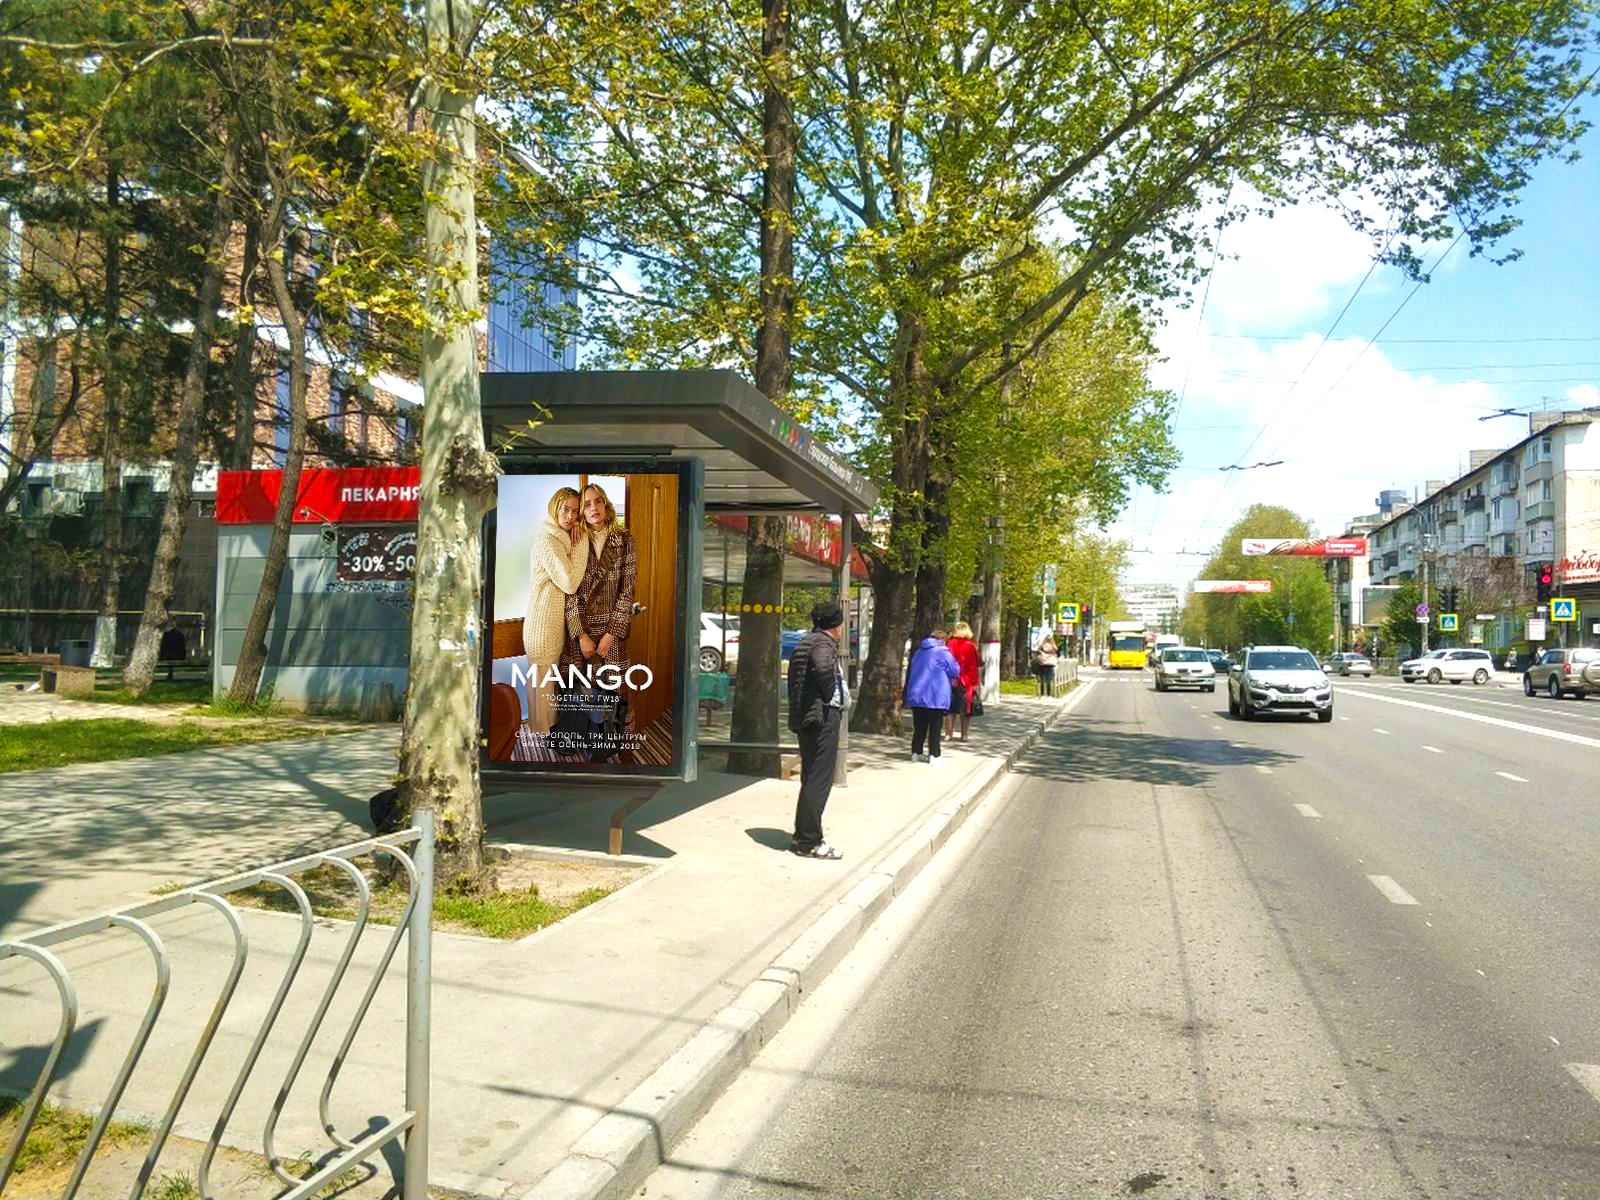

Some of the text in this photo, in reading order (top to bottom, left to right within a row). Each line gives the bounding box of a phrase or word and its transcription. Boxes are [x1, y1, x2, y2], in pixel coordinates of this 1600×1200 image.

[341, 486, 421, 502] ПЕКАРНЯ
[343, 555, 385, 572] -30%
[511, 662, 654, 691] MANGO
[597, 694, 620, 703] FW18
[588, 732, 604, 740] ТРК
[607, 732, 647, 742] ЦЕНТРУМ
[558, 740, 617, 750] ОСЕНЬ-ЗИМА
[619, 742, 641, 750] 2018
